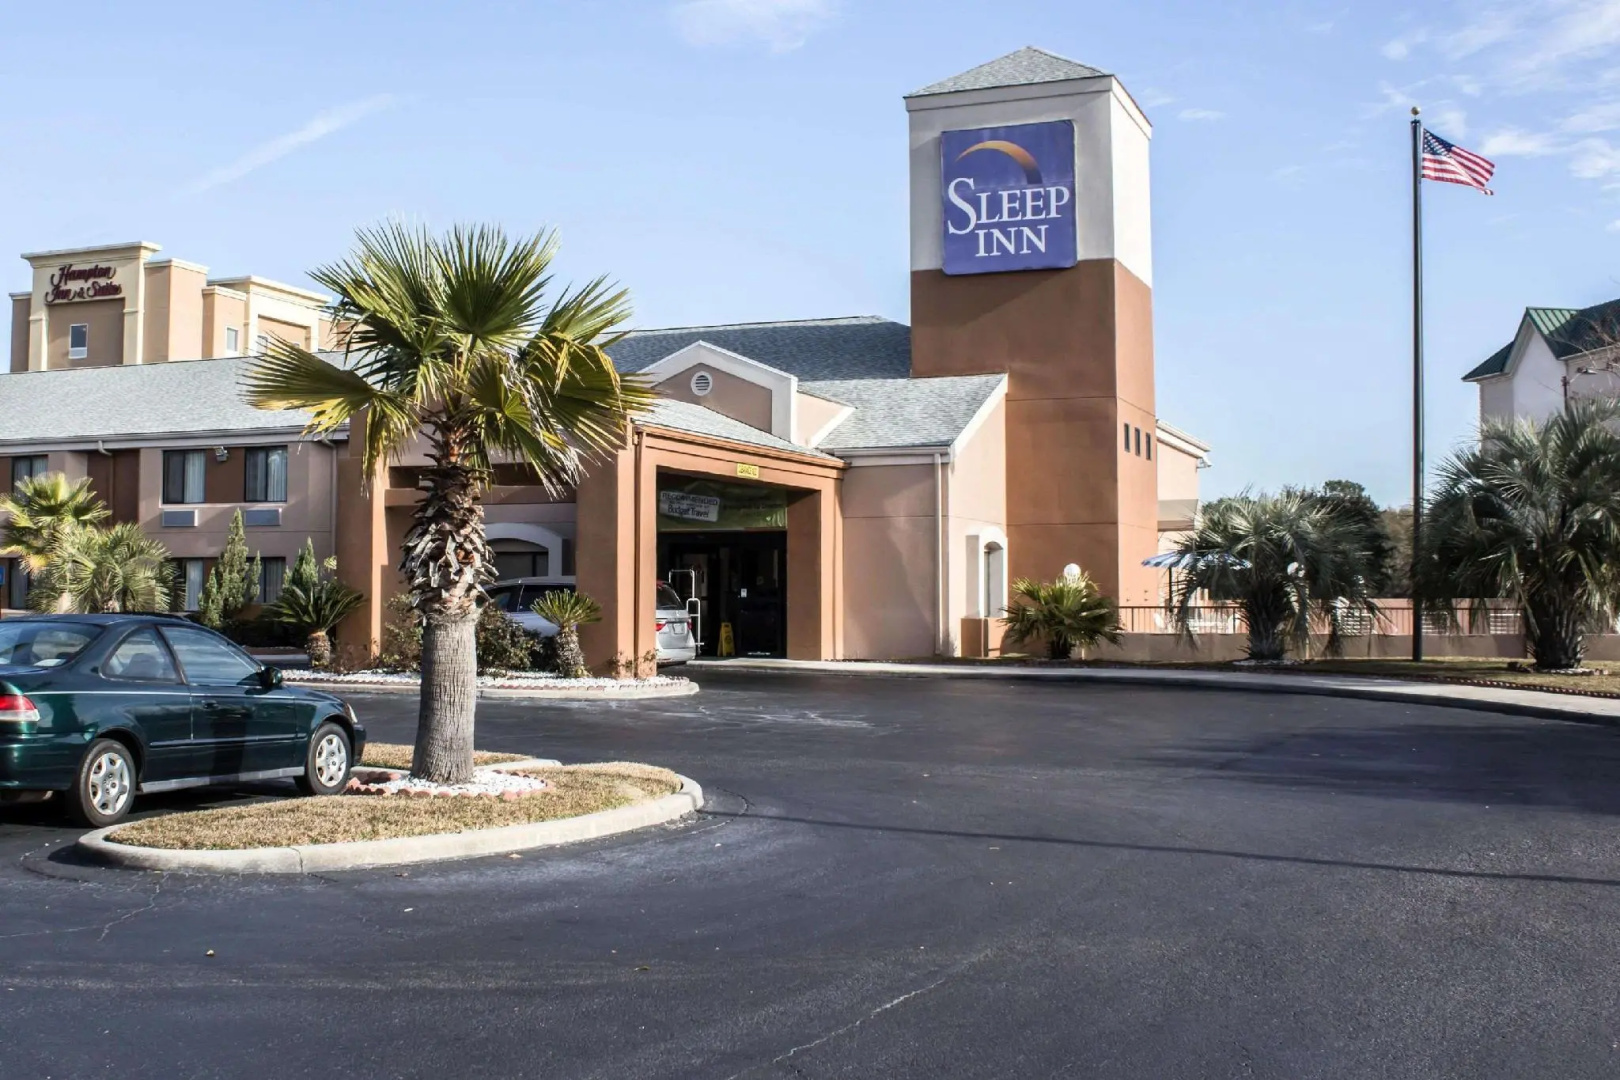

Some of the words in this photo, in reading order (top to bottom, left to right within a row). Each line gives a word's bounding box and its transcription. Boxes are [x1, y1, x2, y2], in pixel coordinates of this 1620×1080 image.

[948, 178, 1069, 235] SLEEP
[975, 225, 1049, 257] INN
[50, 264, 116, 286] Hampton
[45, 285, 76, 303] Inn
[87, 281, 122, 297] Suites
[662, 492, 718, 505] RECOMMENDED
[668, 504, 690, 516] Budget
[690, 508, 709, 518] Travel
